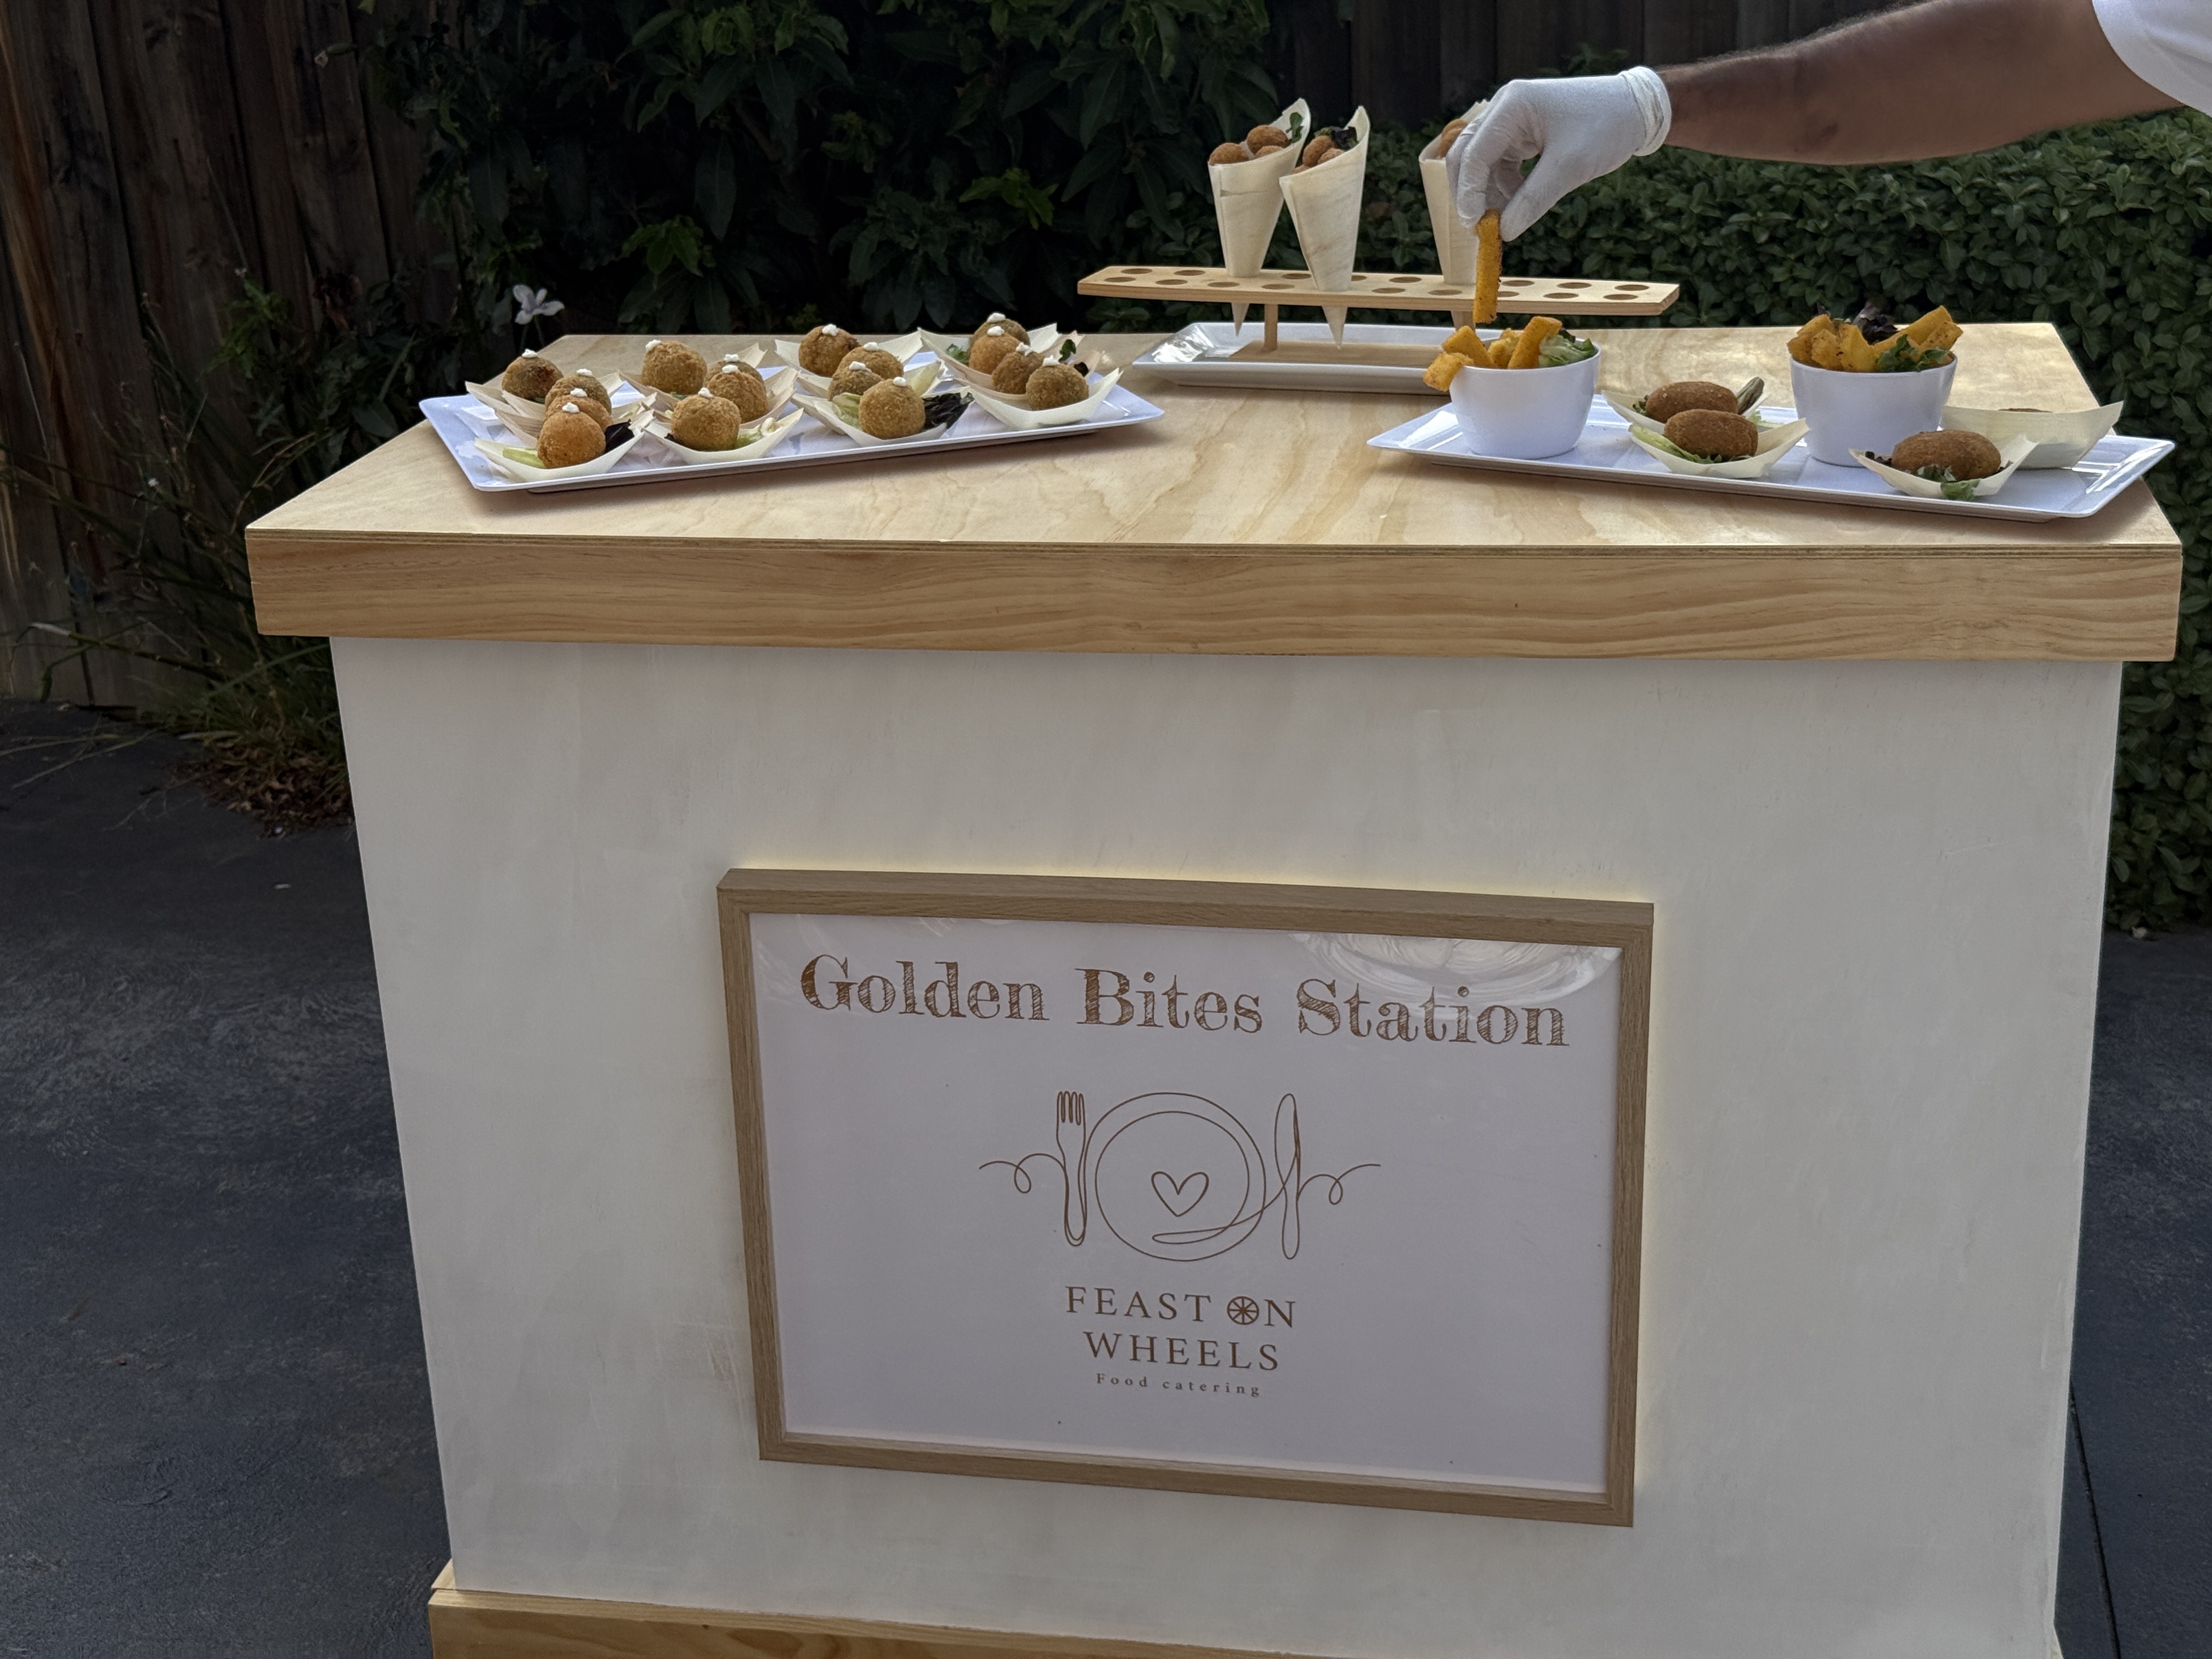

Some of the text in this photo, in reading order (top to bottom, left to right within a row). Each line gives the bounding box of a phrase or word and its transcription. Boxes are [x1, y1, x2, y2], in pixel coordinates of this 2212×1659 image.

[800, 954, 1570, 1047] Golden Bites Station
[1065, 1285, 1211, 1322] FEAST
[1083, 1330, 1278, 1371] WHEELS
[1097, 1373, 1259, 1398] Food catering
